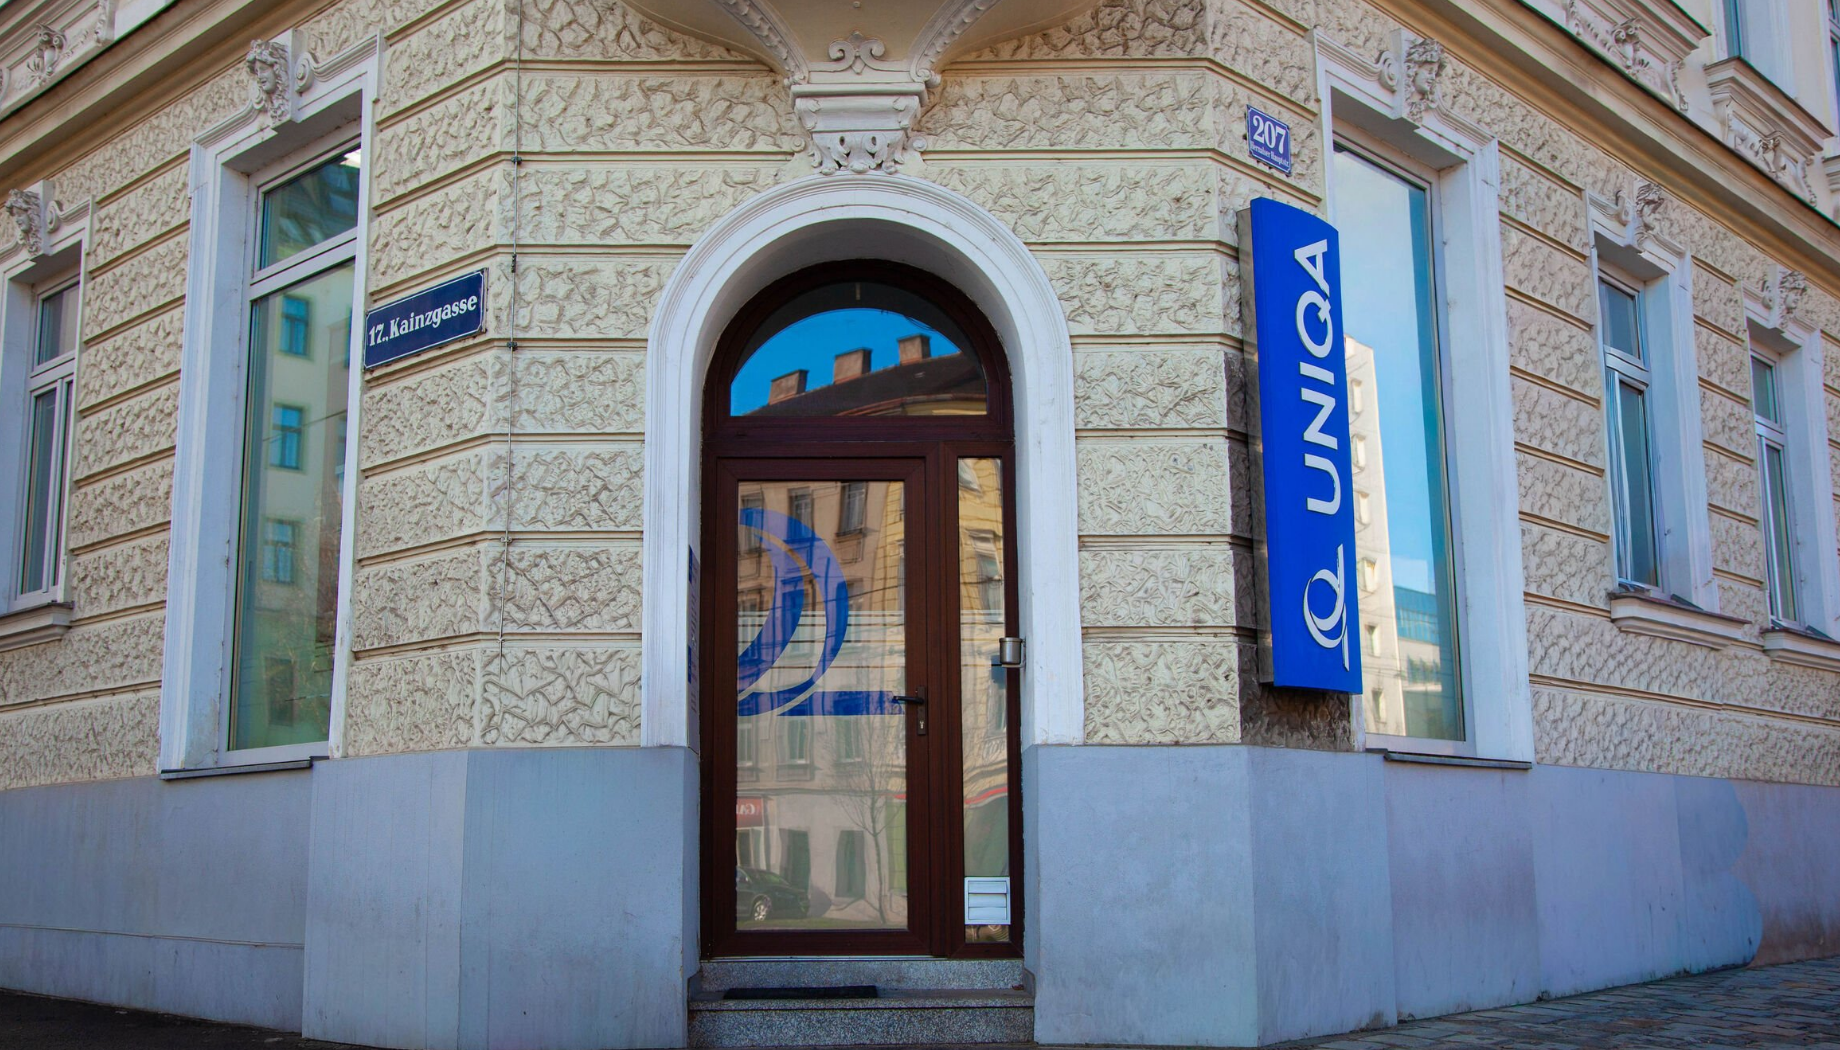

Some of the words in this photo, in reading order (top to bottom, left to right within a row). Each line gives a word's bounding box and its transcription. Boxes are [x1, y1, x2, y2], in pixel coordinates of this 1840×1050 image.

[1252, 115, 1287, 154] 207
[389, 295, 478, 339] Kainzgasse
[1294, 239, 1341, 515] UNIQA
